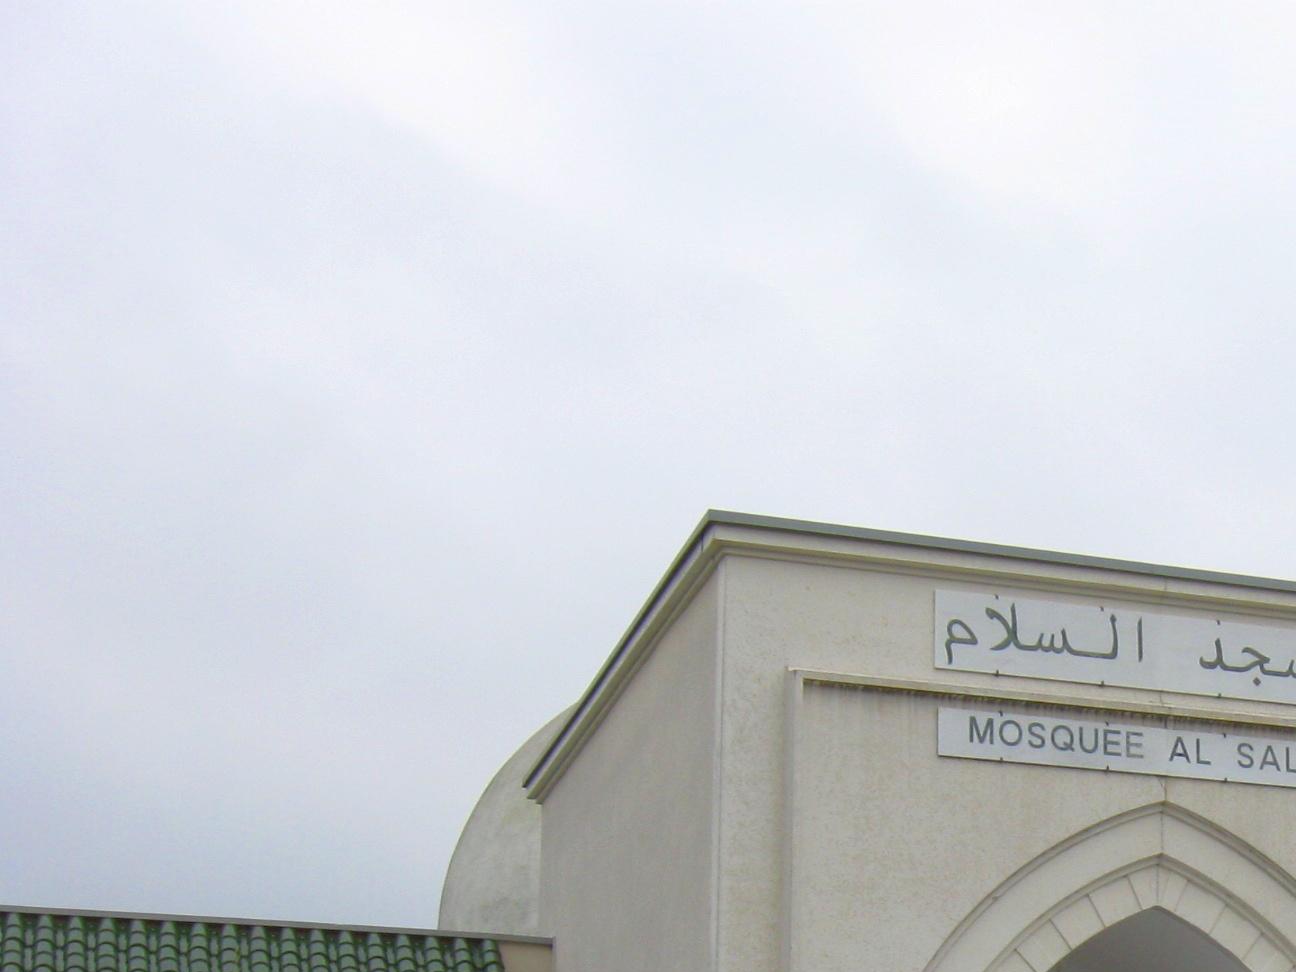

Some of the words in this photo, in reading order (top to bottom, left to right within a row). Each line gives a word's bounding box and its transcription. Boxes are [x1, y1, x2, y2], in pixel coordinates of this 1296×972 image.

[944, 602, 1144, 665] السلام
[968, 715, 1145, 760] MOSQUEE
[1169, 736, 1212, 765] AL
